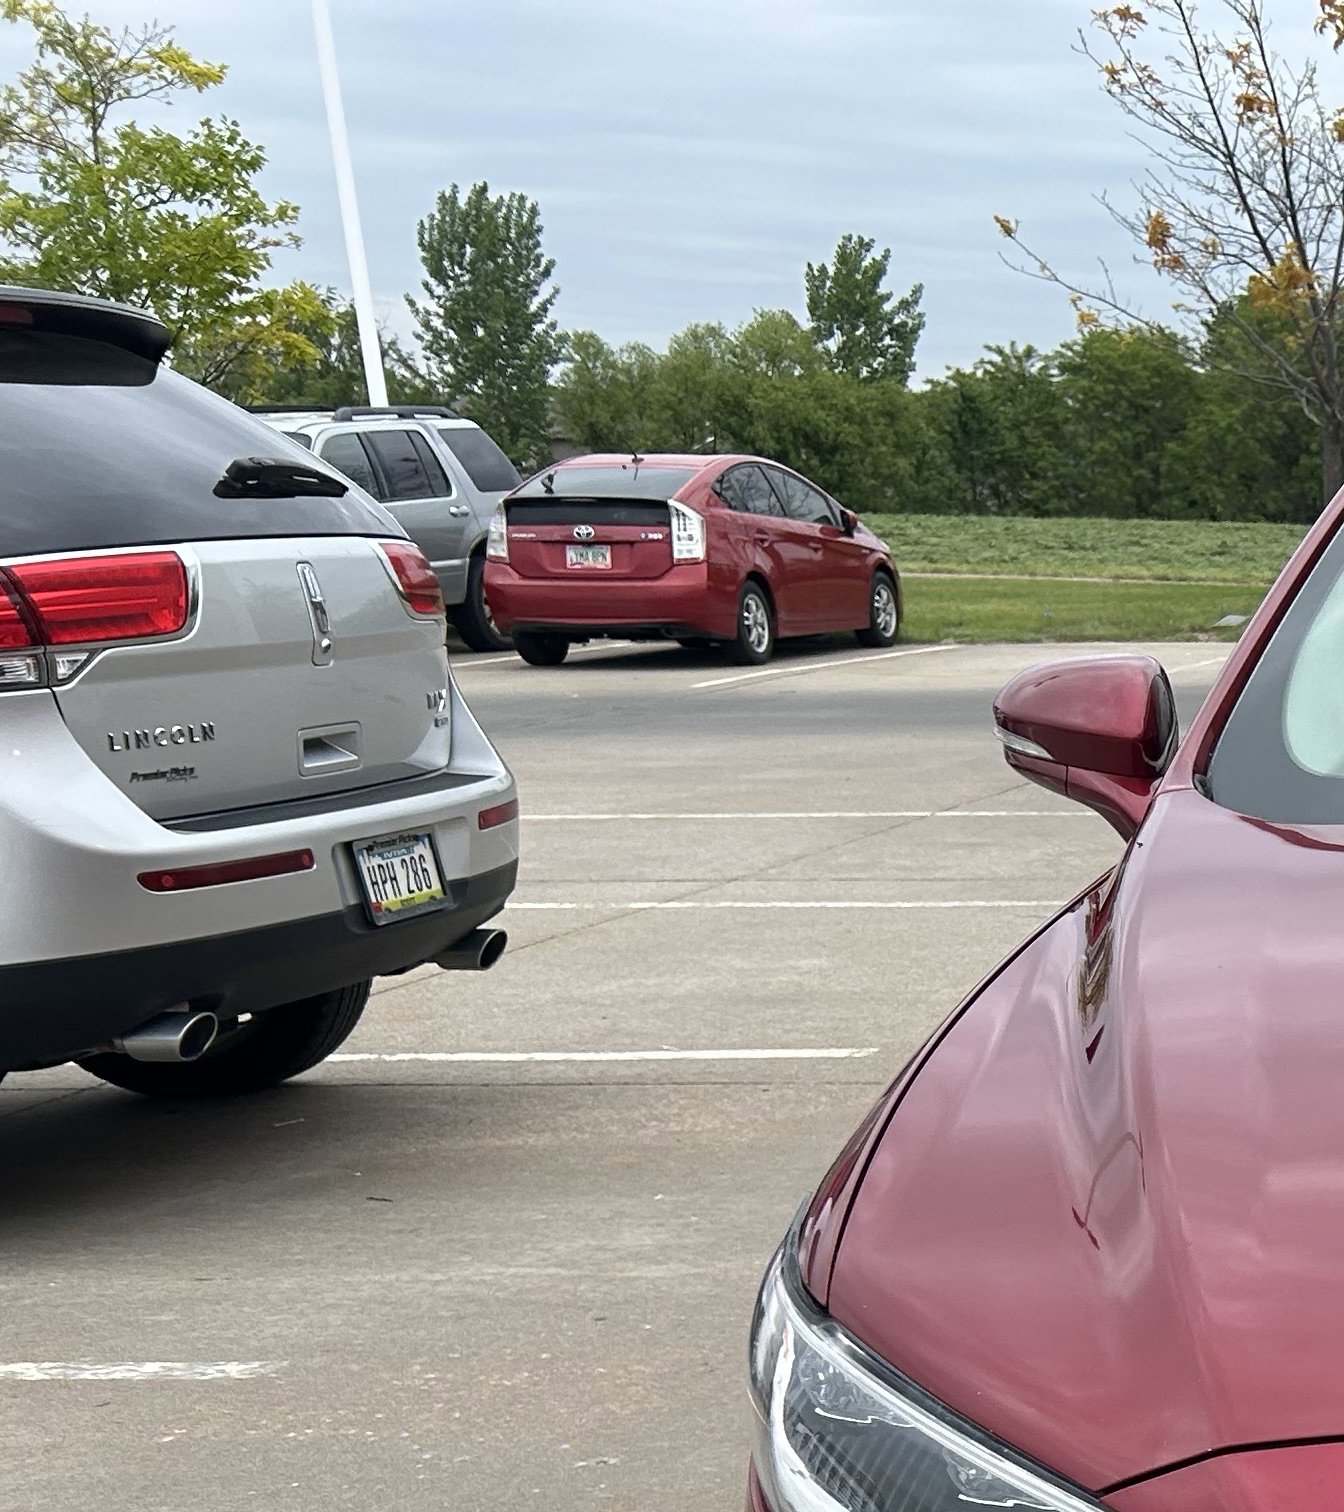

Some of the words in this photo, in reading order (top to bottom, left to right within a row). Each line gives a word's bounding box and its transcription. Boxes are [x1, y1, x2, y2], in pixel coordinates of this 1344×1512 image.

[107, 721, 216, 752] LINCOLN
[367, 860, 402, 902] HPH
[401, 853, 432, 894] 286
